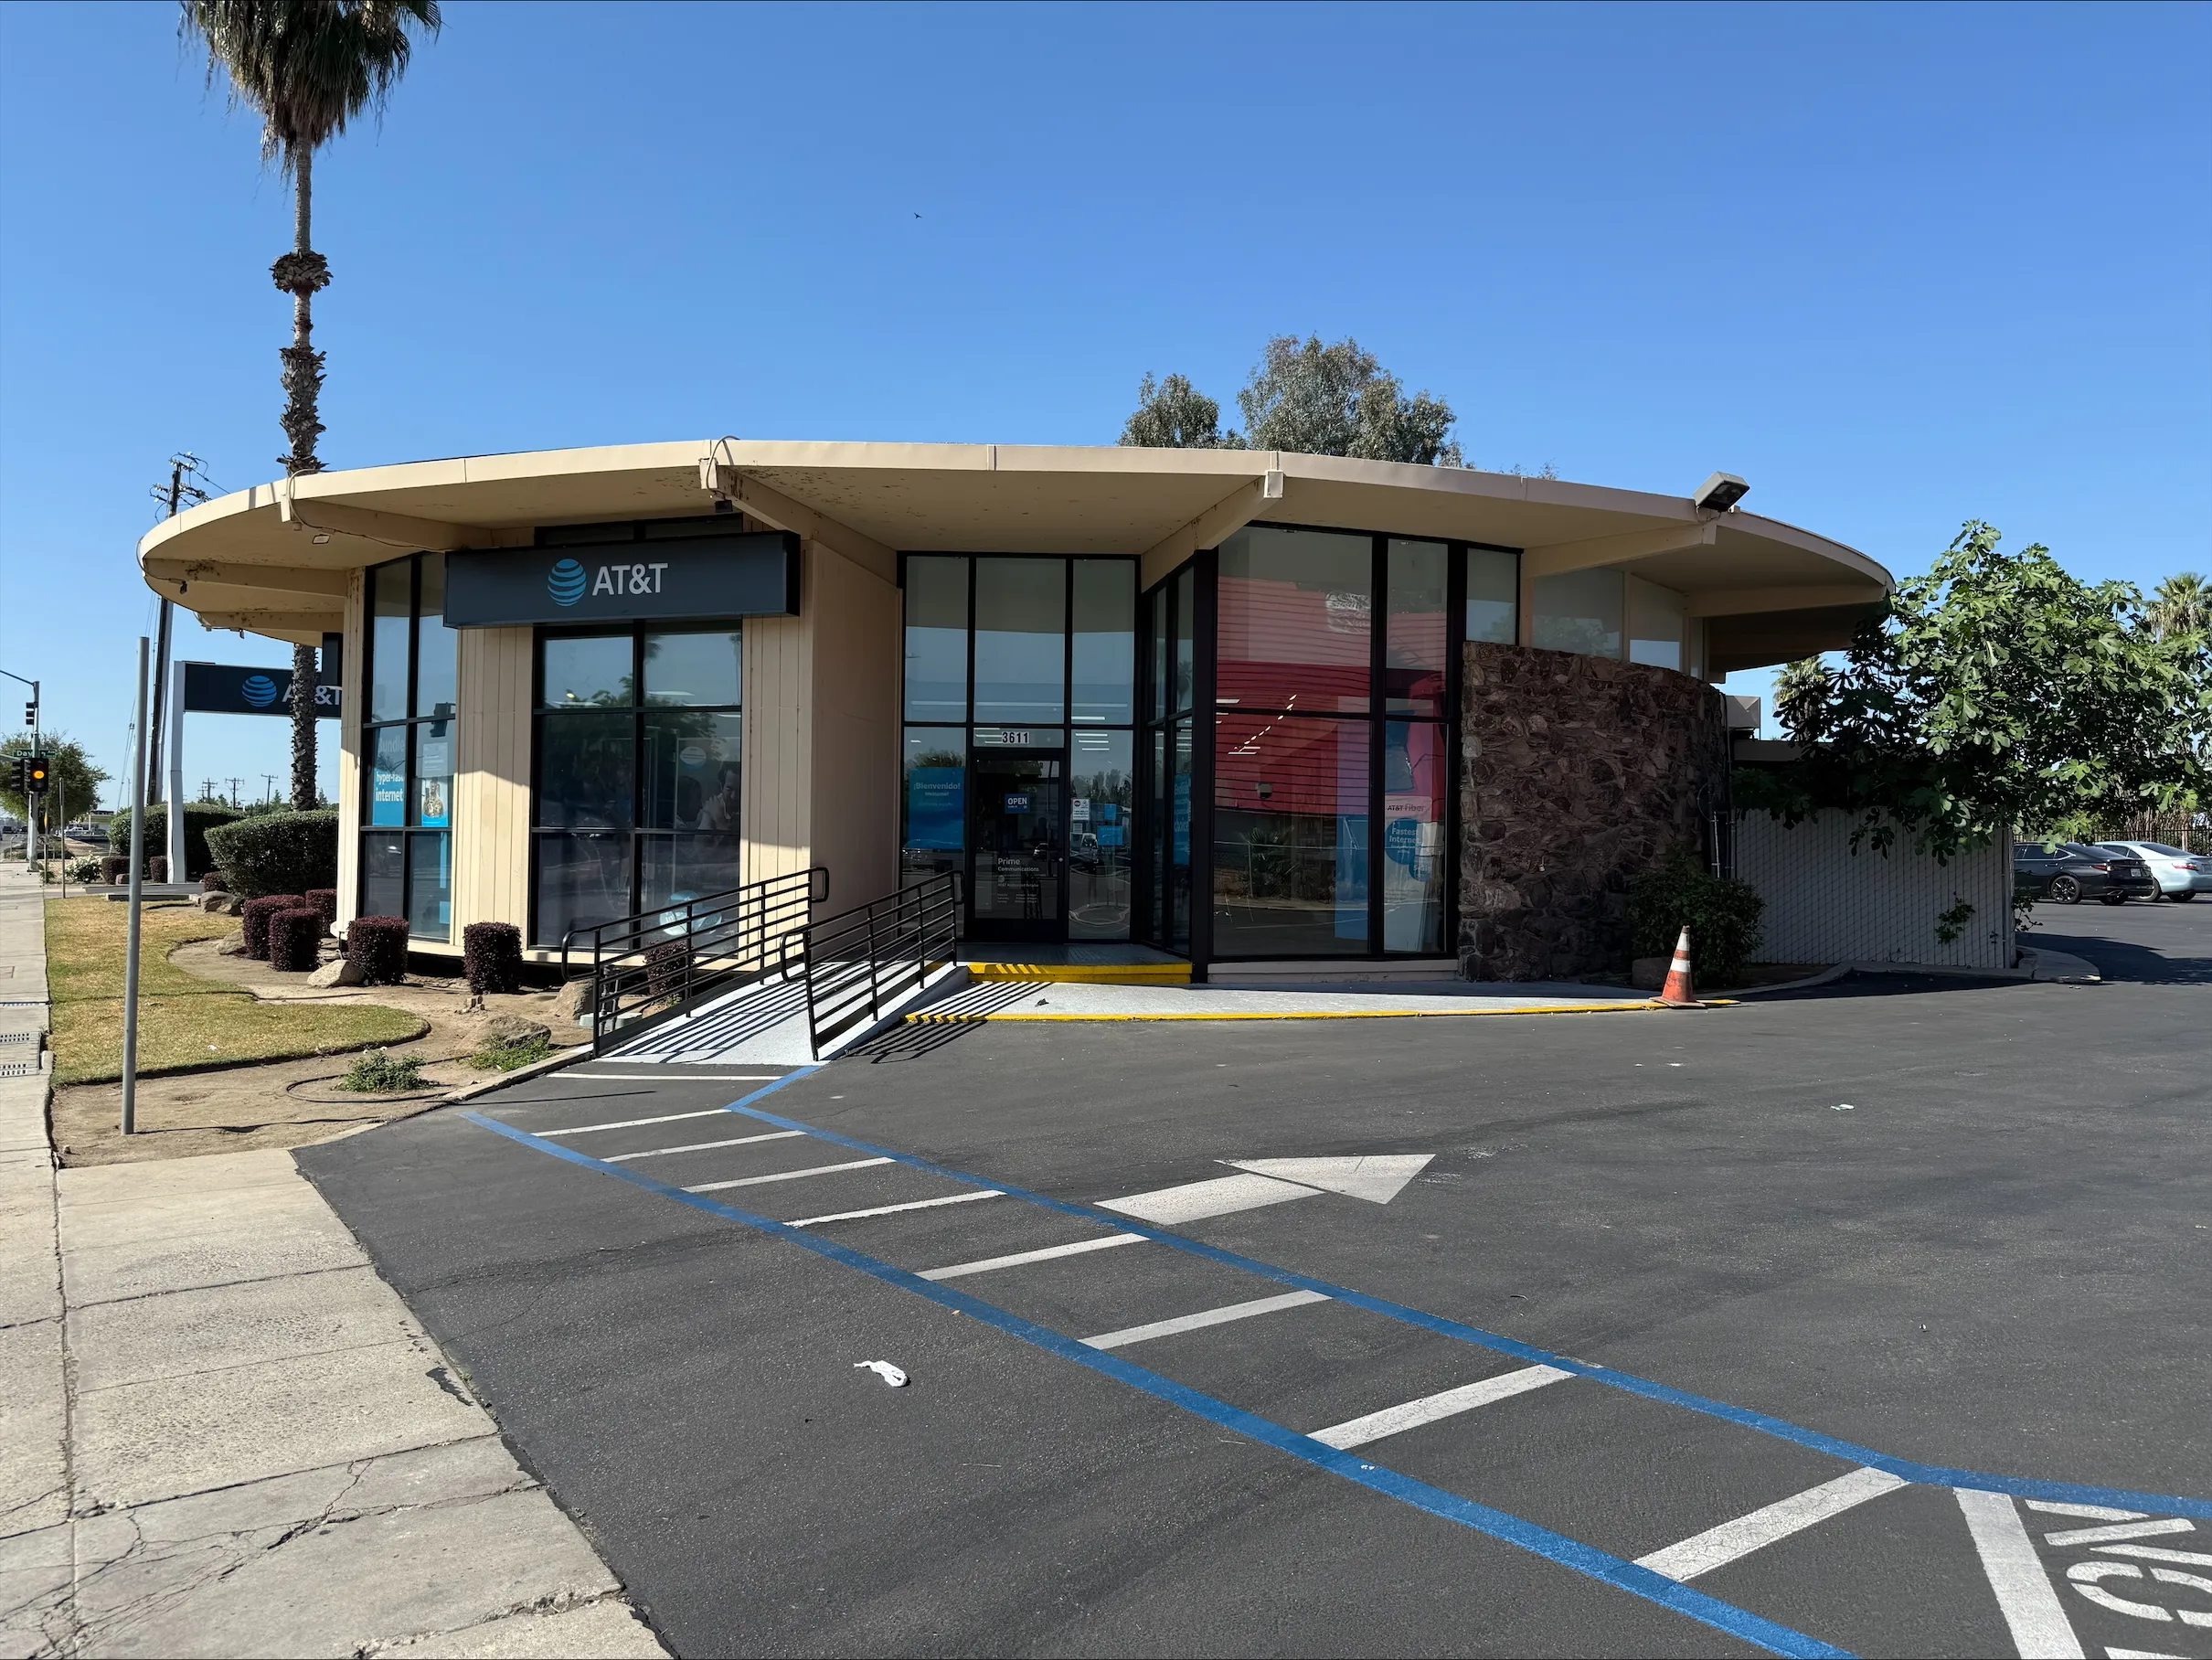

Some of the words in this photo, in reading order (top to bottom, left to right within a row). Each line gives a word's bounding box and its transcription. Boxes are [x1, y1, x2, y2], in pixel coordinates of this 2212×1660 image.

[592, 562, 669, 596] AT&T
[282, 684, 342, 705] A&T
[1003, 732, 1027, 743] 3611
[375, 788, 404, 802] internet
[1007, 797, 1027, 805] OPEN
